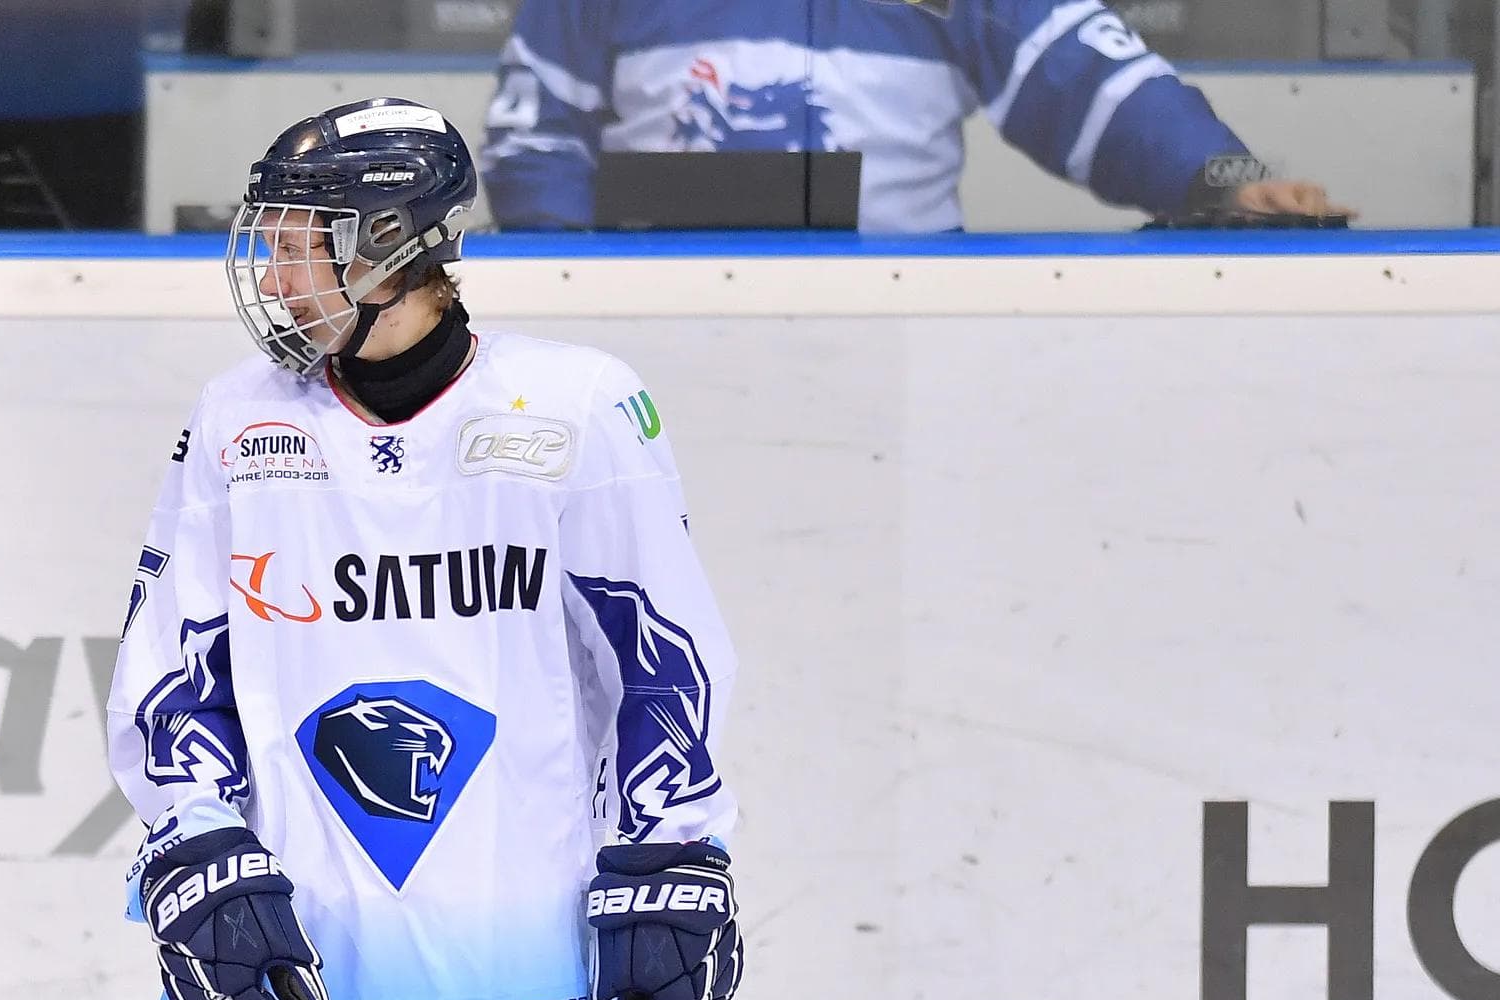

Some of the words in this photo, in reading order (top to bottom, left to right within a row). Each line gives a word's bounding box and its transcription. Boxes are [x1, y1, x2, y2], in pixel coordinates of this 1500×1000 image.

[362, 171, 415, 183] BAUER
[240, 435, 306, 458] SATURN
[248, 457, 328, 470] ARENA
[156, 852, 283, 934] BAUER
[588, 883, 726, 916] BAUER
